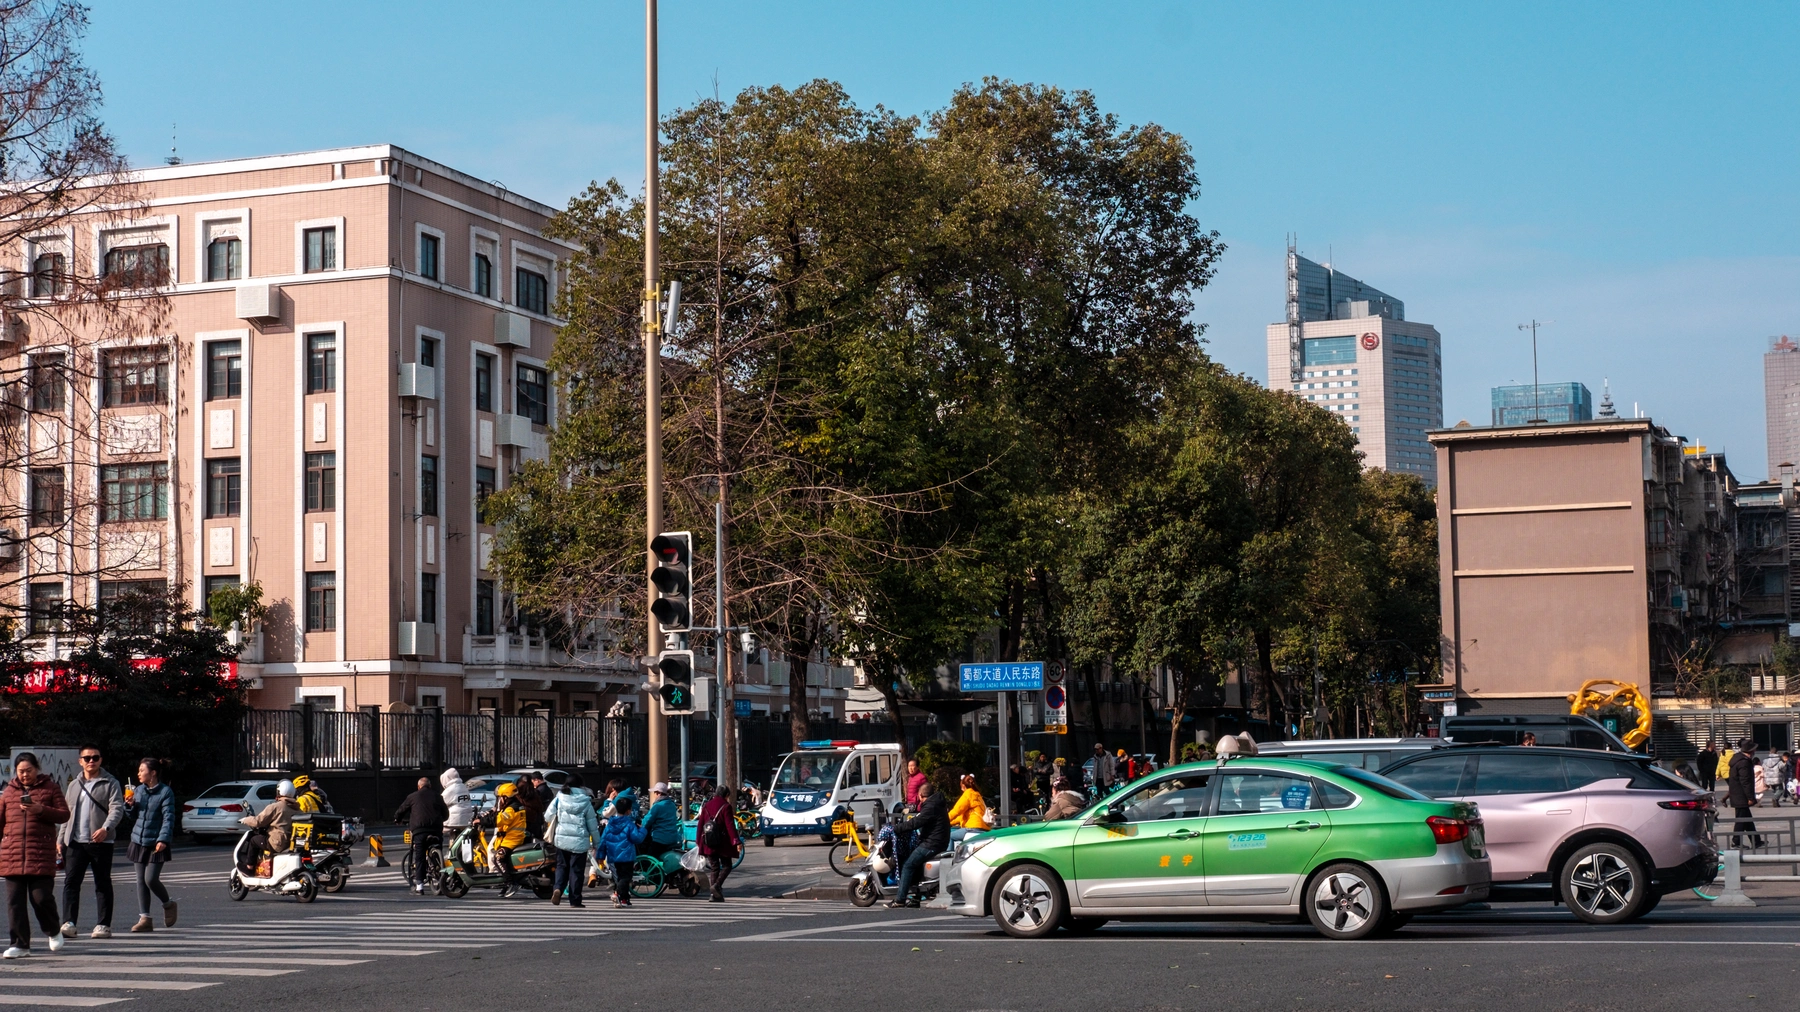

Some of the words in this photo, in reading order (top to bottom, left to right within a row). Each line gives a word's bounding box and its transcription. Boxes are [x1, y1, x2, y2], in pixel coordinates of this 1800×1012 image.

[964, 666, 1040, 681] 蜀都大道人民东路
[1050, 666, 1061, 676] 60
[1237, 833, 1266, 842] 12328
